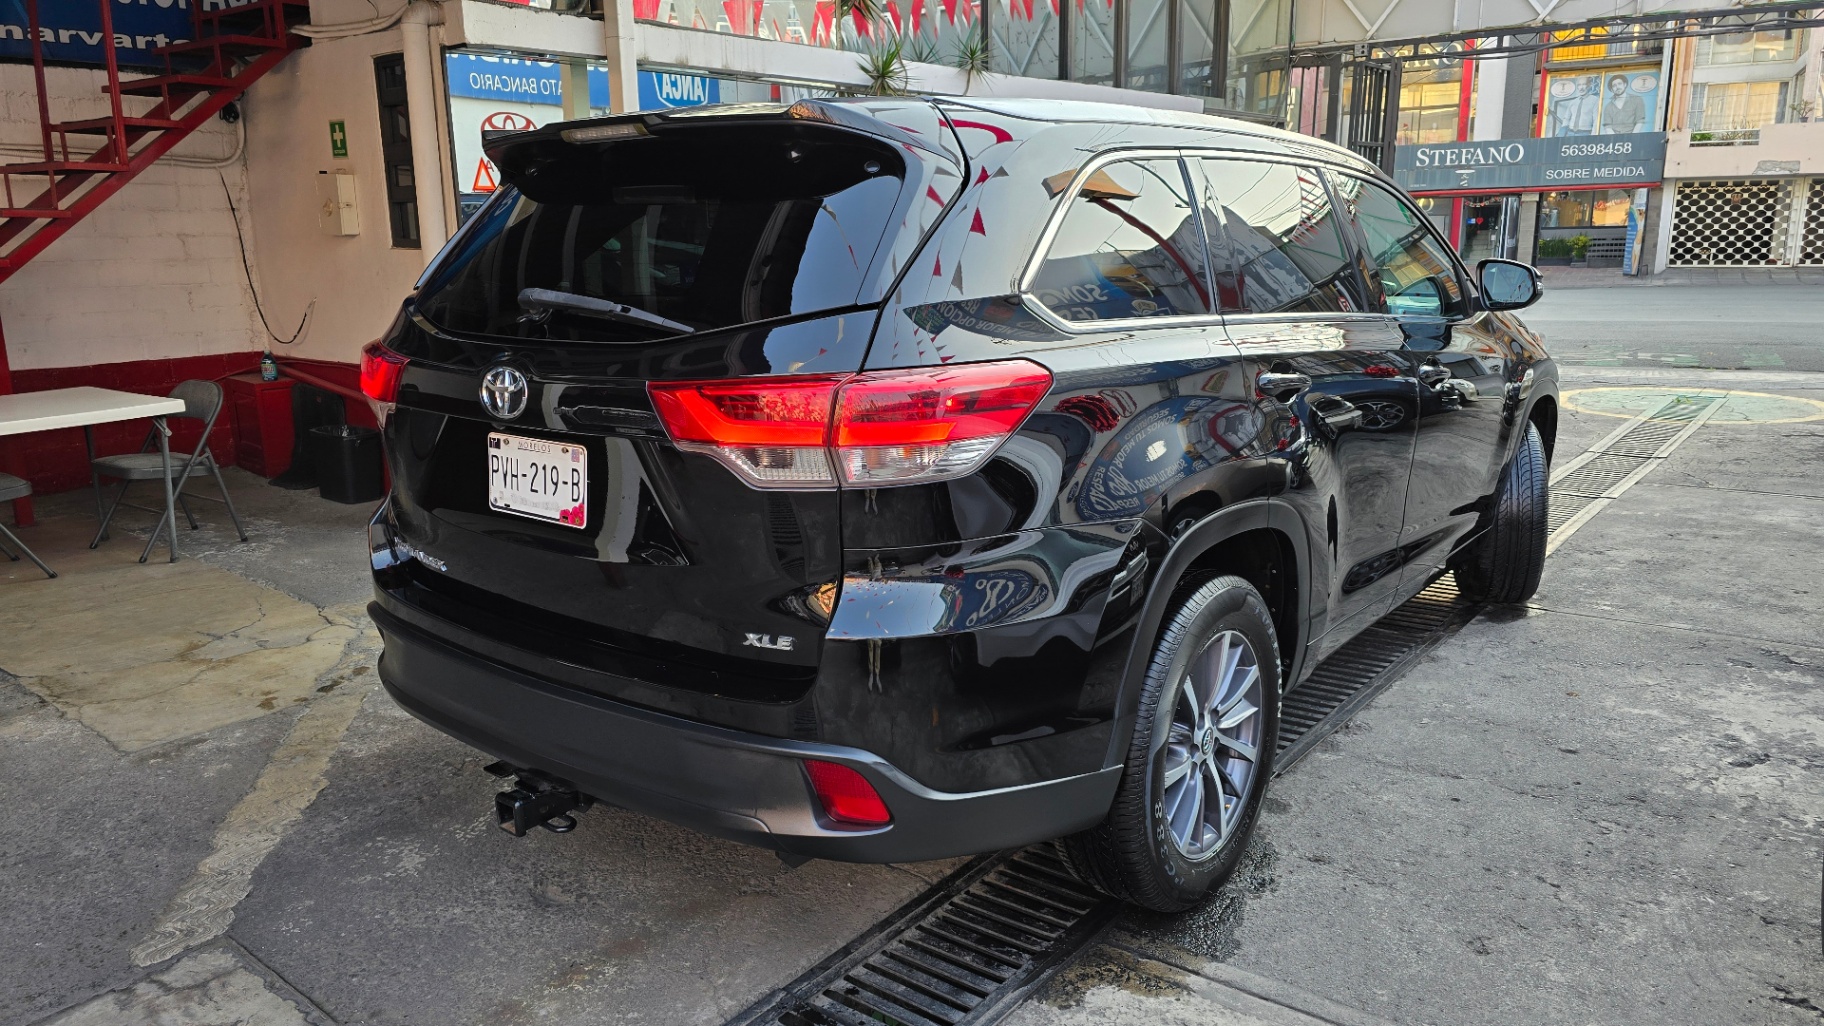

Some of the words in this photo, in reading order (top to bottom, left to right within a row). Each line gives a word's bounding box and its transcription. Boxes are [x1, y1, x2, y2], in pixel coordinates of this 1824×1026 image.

[0, 24, 191, 50] narvart
[1416, 143, 1525, 167] STEFANO
[1561, 142, 1632, 157] 56398458
[1546, 168, 1590, 180] SOBRE
[1593, 166, 1645, 178] MEDIDA
[518, 441, 551, 454] MORELOS
[491, 454, 581, 502] PVH-219-B
[742, 632, 797, 651] XLE
